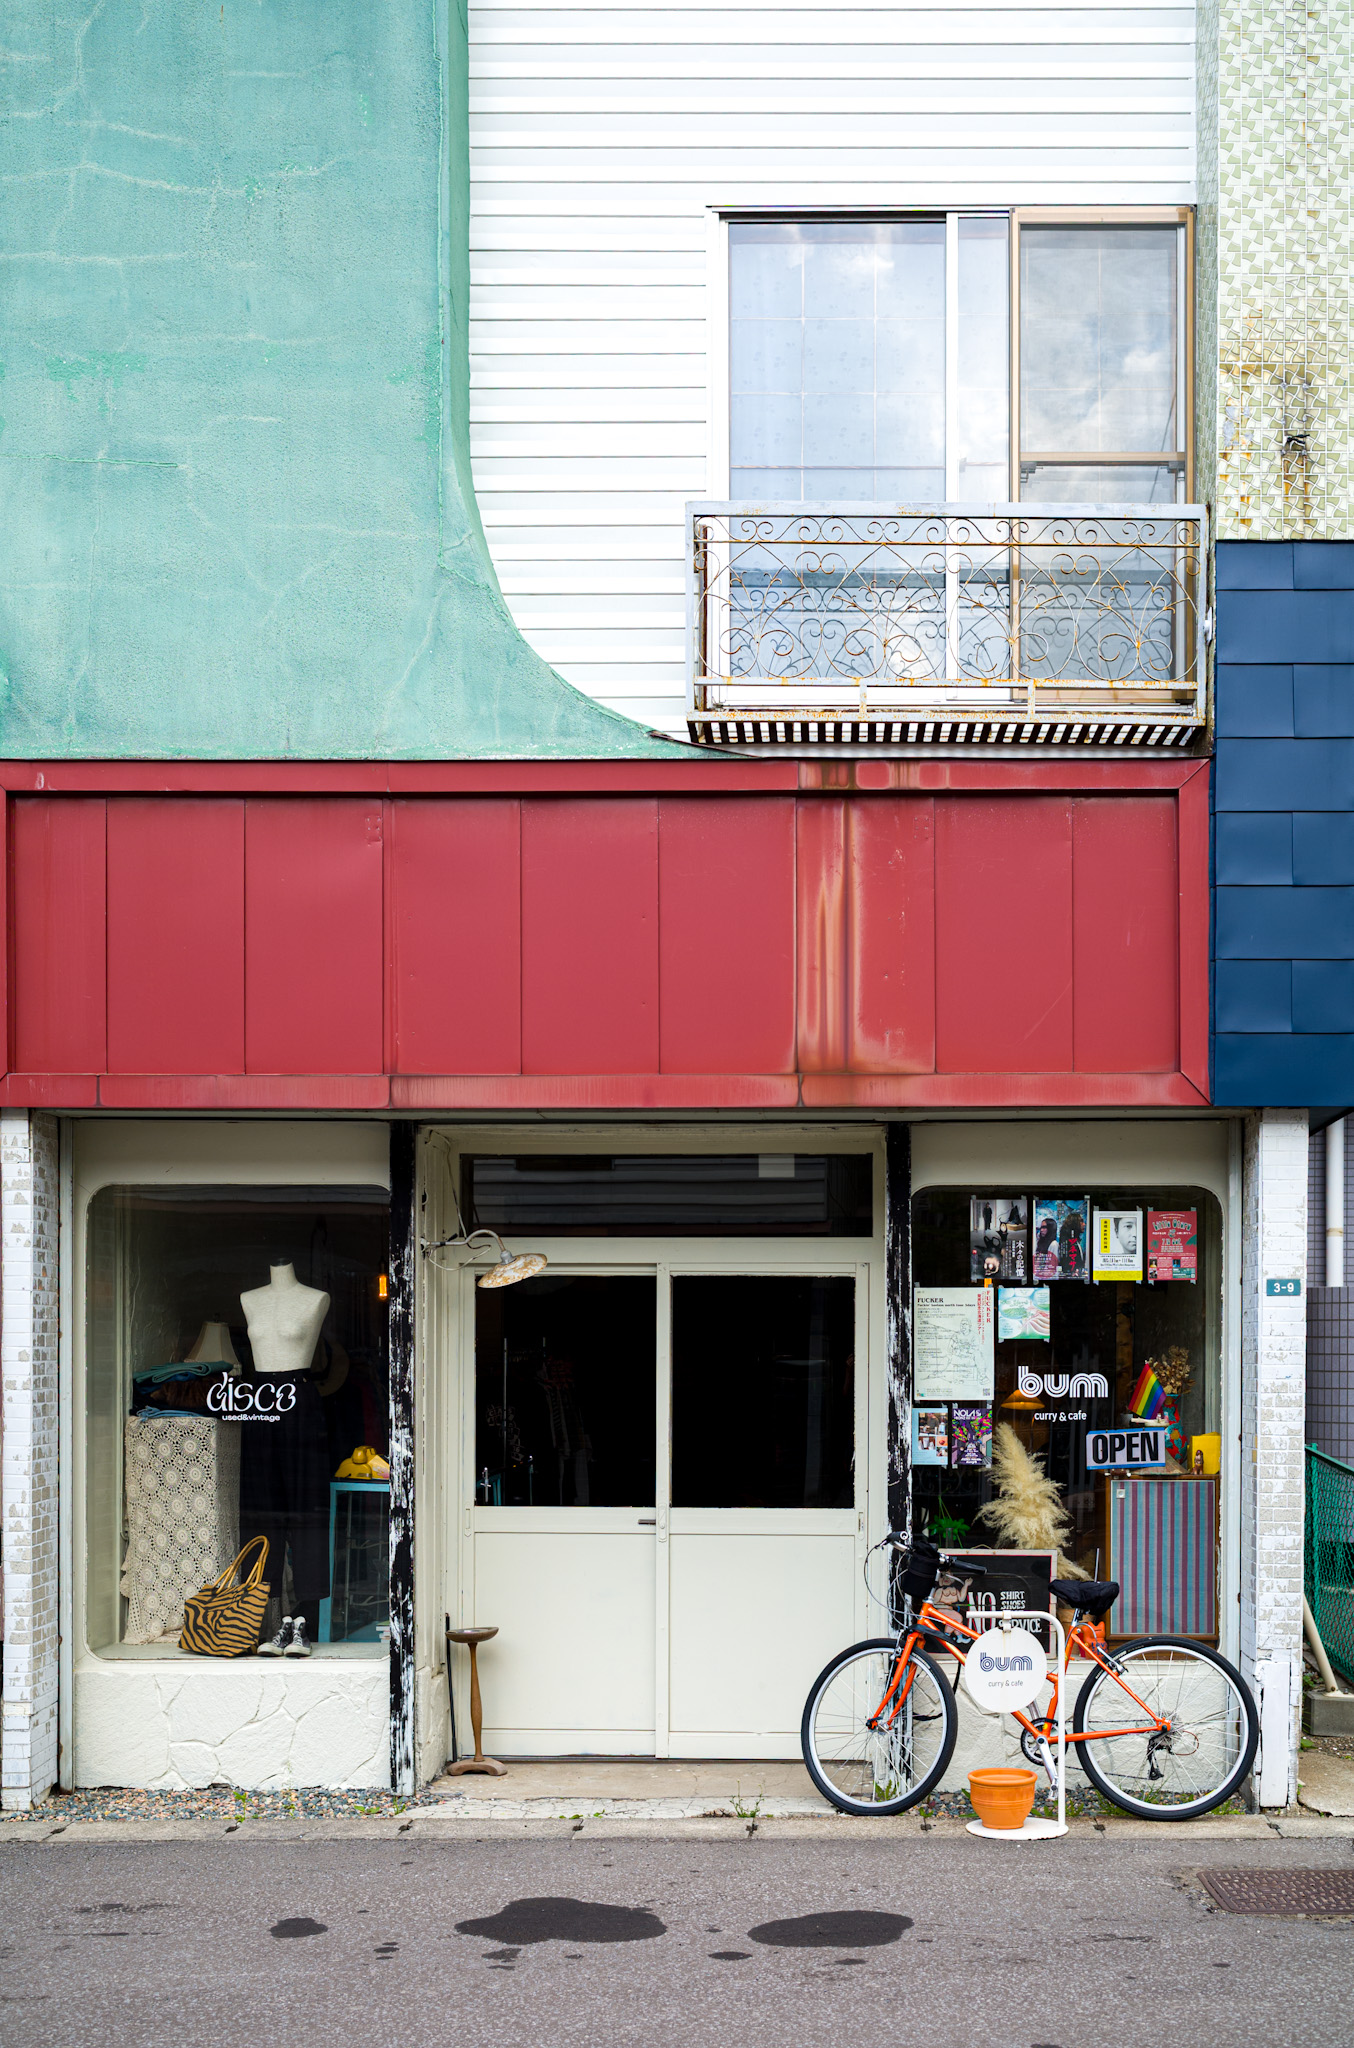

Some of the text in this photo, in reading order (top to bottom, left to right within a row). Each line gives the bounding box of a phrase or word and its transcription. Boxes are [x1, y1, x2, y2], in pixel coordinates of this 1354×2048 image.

[1273, 1282, 1295, 1293] 3-9
[1018, 1365, 1108, 1398] bum
[206, 1371, 296, 1412] disco
[222, 1414, 281, 1422] used&vintage
[1034, 1410, 1087, 1422] curry & cafe
[1092, 1432, 1159, 1464] OPEN
[1000, 1590, 1026, 1600] SHIRT
[1000, 1600, 1026, 1610] SHOES
[967, 1591, 997, 1634] NO
[979, 1652, 1033, 1672] bum
[988, 1679, 1024, 1688] curry & cafe
